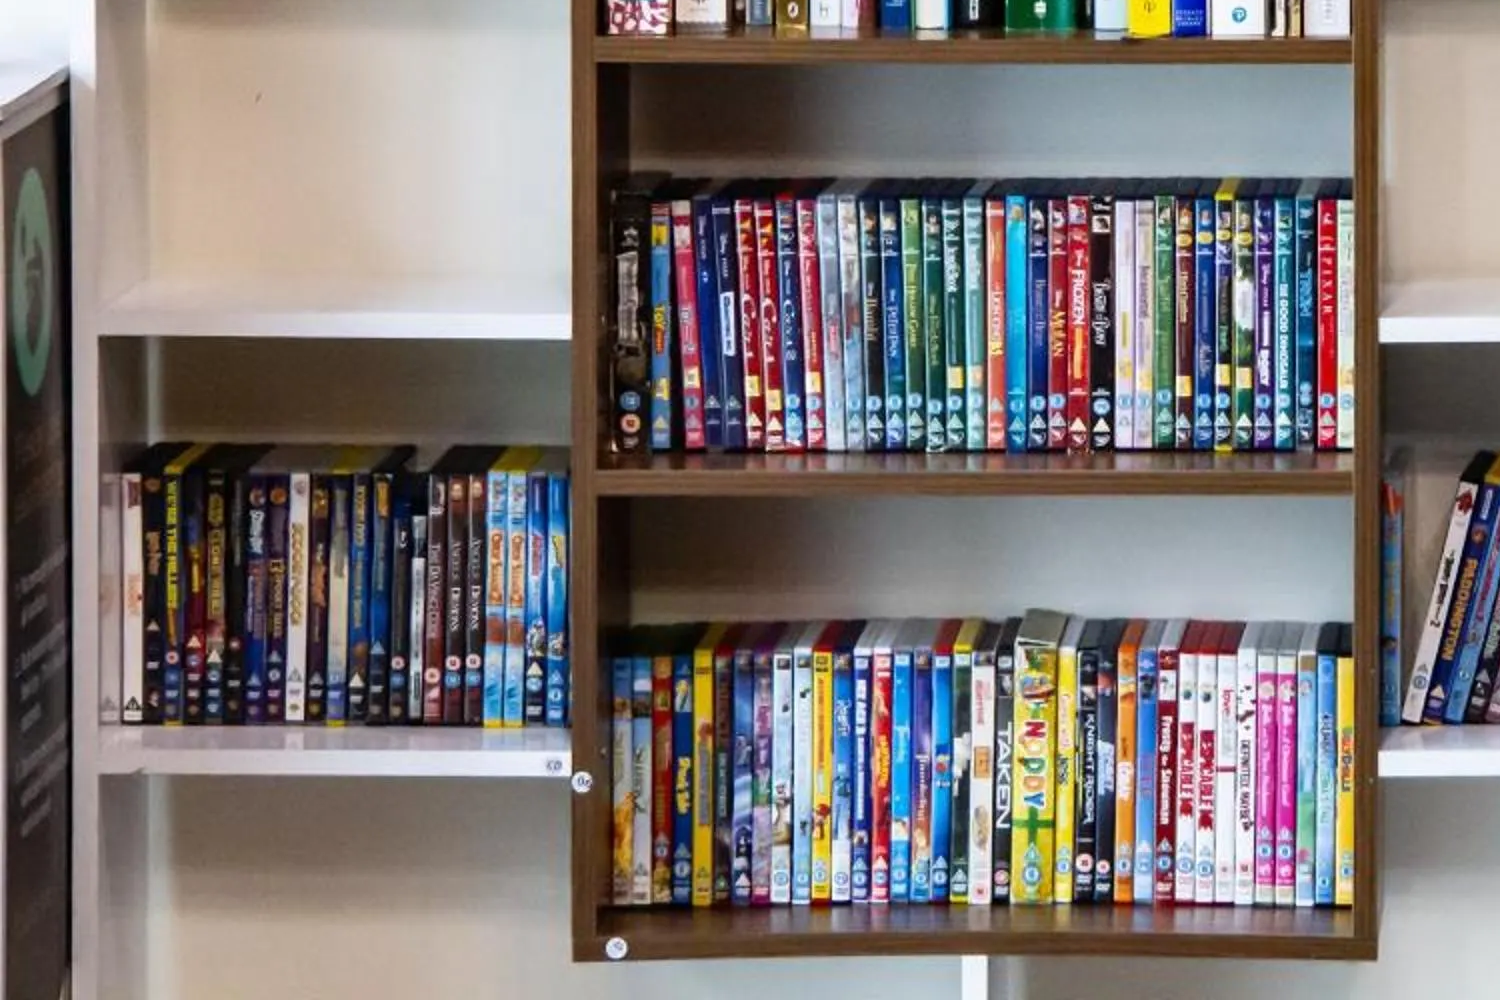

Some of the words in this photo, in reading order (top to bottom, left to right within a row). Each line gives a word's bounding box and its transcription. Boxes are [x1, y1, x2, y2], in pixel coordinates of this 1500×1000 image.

[1072, 269, 1086, 325] FROZEN
[1321, 256, 1333, 315] PIXAR
[1051, 311, 1067, 358] MULAN
[1279, 298, 1289, 332] GOOD
[1279, 333, 1289, 389] DINOSAUR
[450, 587, 461, 632] DEMONS
[470, 584, 481, 631] DEMONS
[1441, 557, 1478, 661] PADDINGTON
[1222, 689, 1234, 716] love
[1084, 713, 1095, 771] KNIGHT
[1160, 715, 1173, 752] Frosty
[996, 721, 1012, 828] TAKEN
[1020, 720, 1048, 809] NODDY
[1199, 729, 1215, 806] DESPICABLE
[1083, 773, 1095, 826] RIDER
[1160, 768, 1173, 825] Snowman
[1239, 791, 1251, 821] MAYBE
